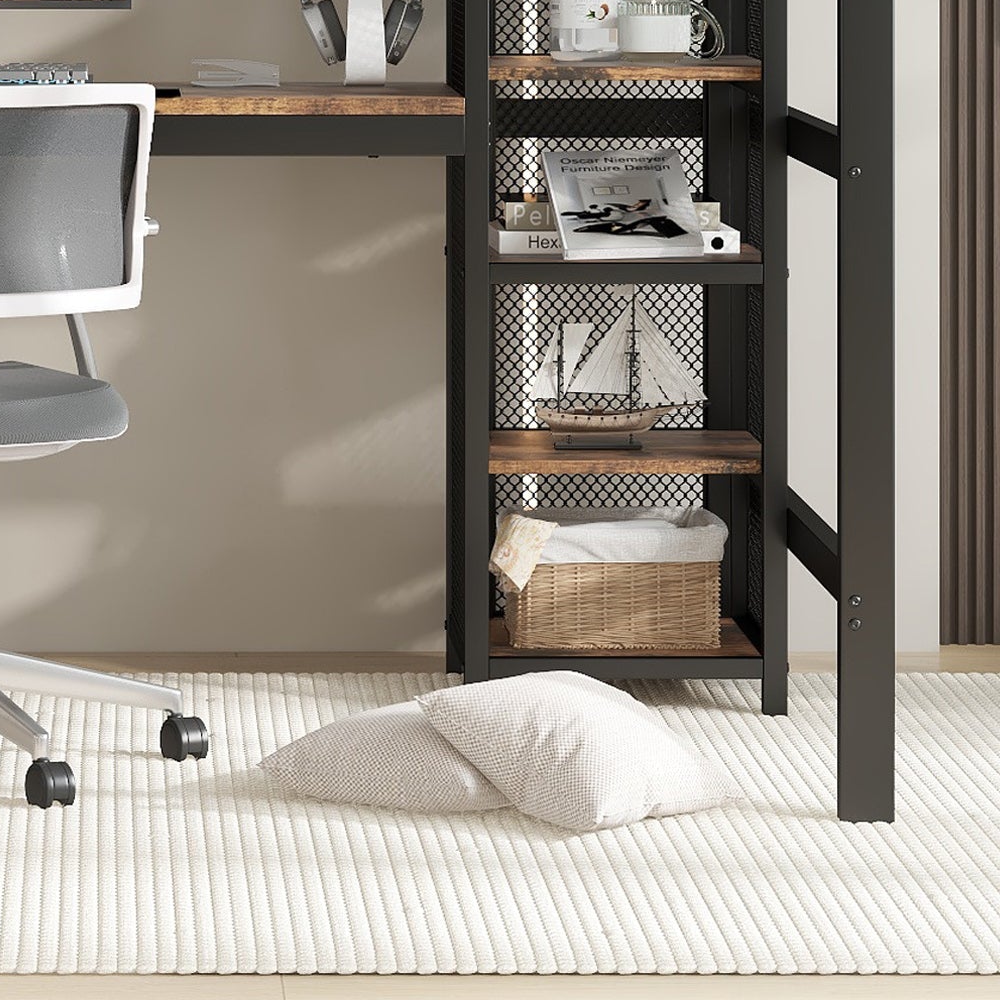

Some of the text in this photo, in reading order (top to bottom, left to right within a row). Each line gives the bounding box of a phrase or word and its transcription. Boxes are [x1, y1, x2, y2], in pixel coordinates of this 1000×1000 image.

[560, 156, 667, 165] Oscar Niemeyer
[561, 164, 671, 173] Furniture Design
[513, 204, 556, 226] Pel
[528, 235, 562, 249] Hex
